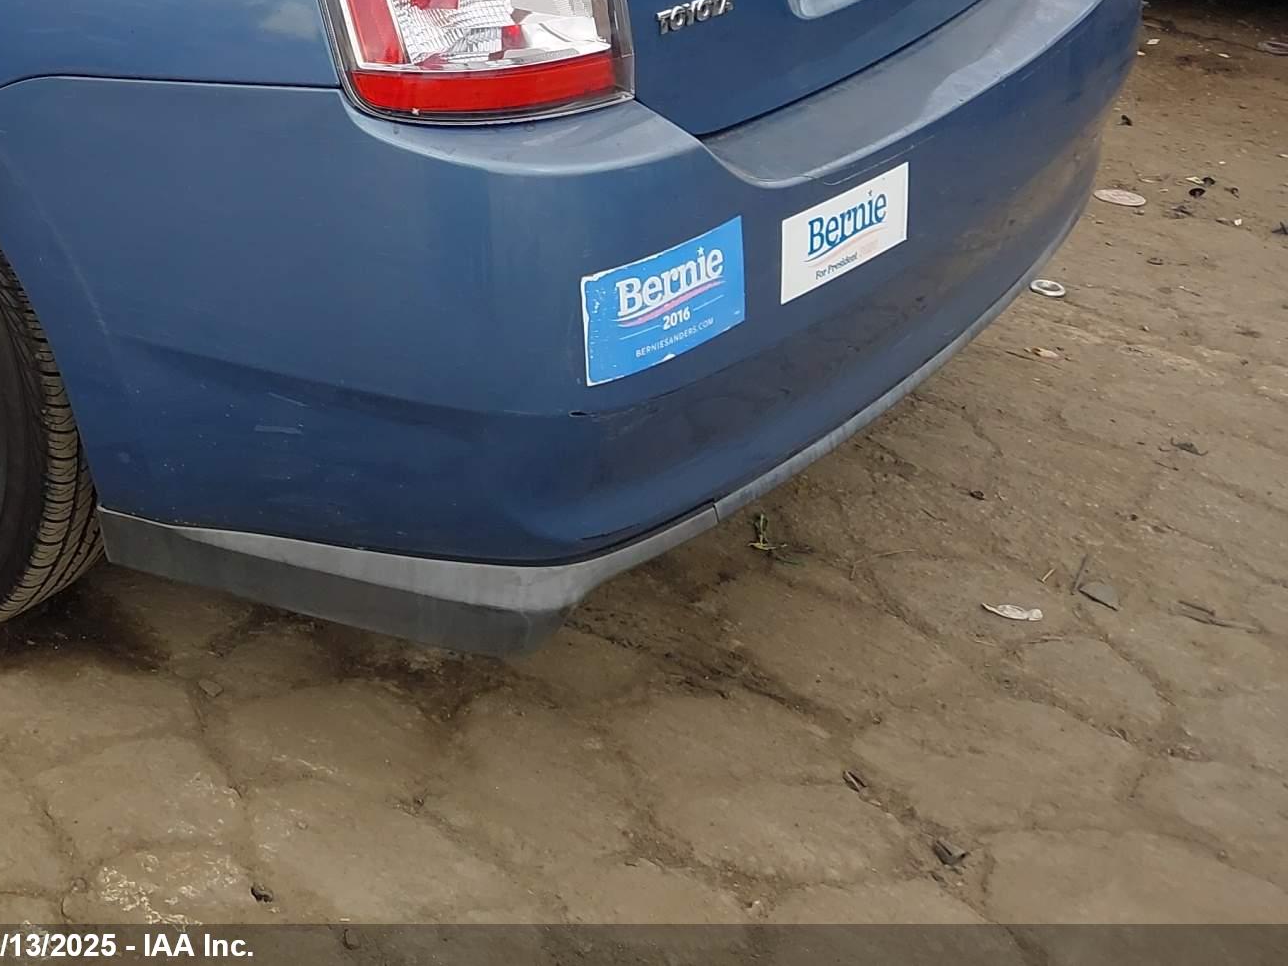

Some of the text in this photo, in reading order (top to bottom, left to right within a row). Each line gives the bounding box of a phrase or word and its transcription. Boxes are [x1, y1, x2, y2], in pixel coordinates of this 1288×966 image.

[808, 190, 887, 255] Bernie
[616, 247, 724, 316] Bernie
[815, 252, 858, 280] For President
[635, 317, 714, 358] BERNIESANDERS.COM
[662, 306, 691, 330] 2016
